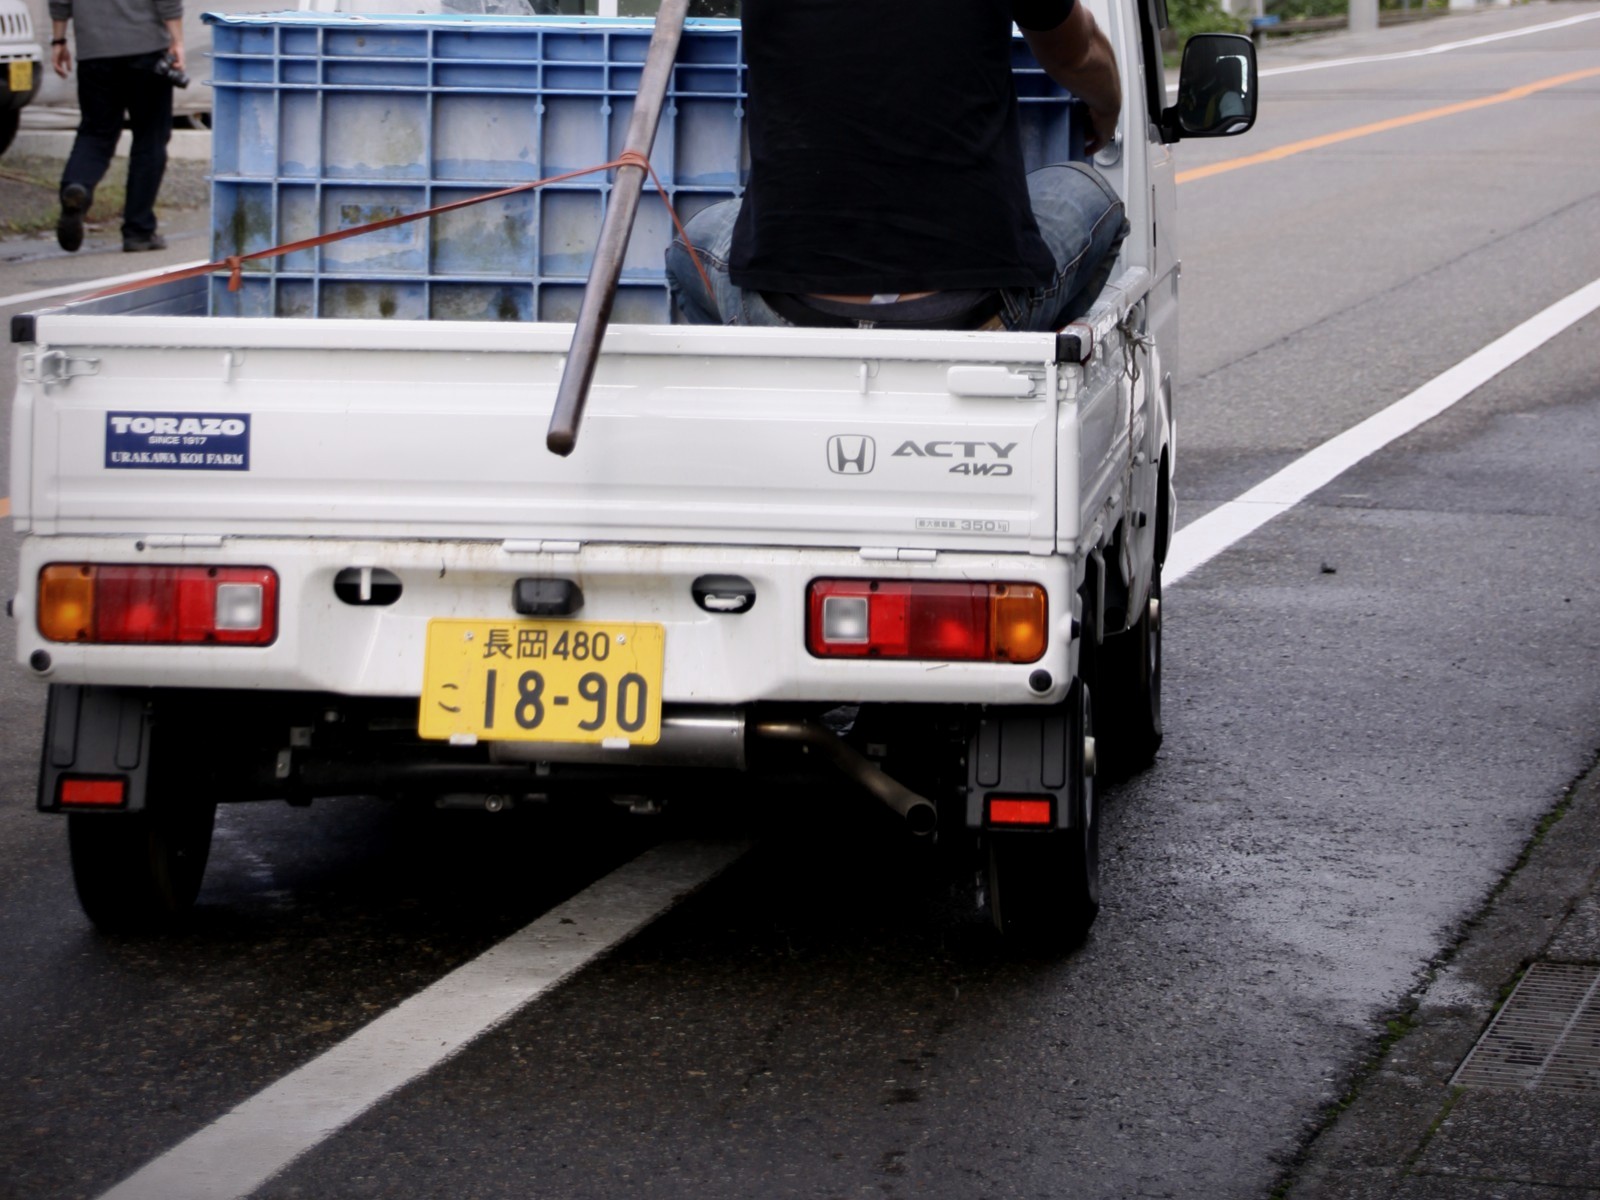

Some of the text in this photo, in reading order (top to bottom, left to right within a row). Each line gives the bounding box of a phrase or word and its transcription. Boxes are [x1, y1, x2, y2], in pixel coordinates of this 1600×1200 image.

[110, 417, 246, 436] TORAZO
[148, 436, 207, 445] SINCE 1917
[890, 440, 1019, 459] ACTY
[111, 451, 244, 465] URAKAWA KOI FARM
[948, 462, 1013, 476] 4WD
[437, 668, 648, 733] こ 18-90
